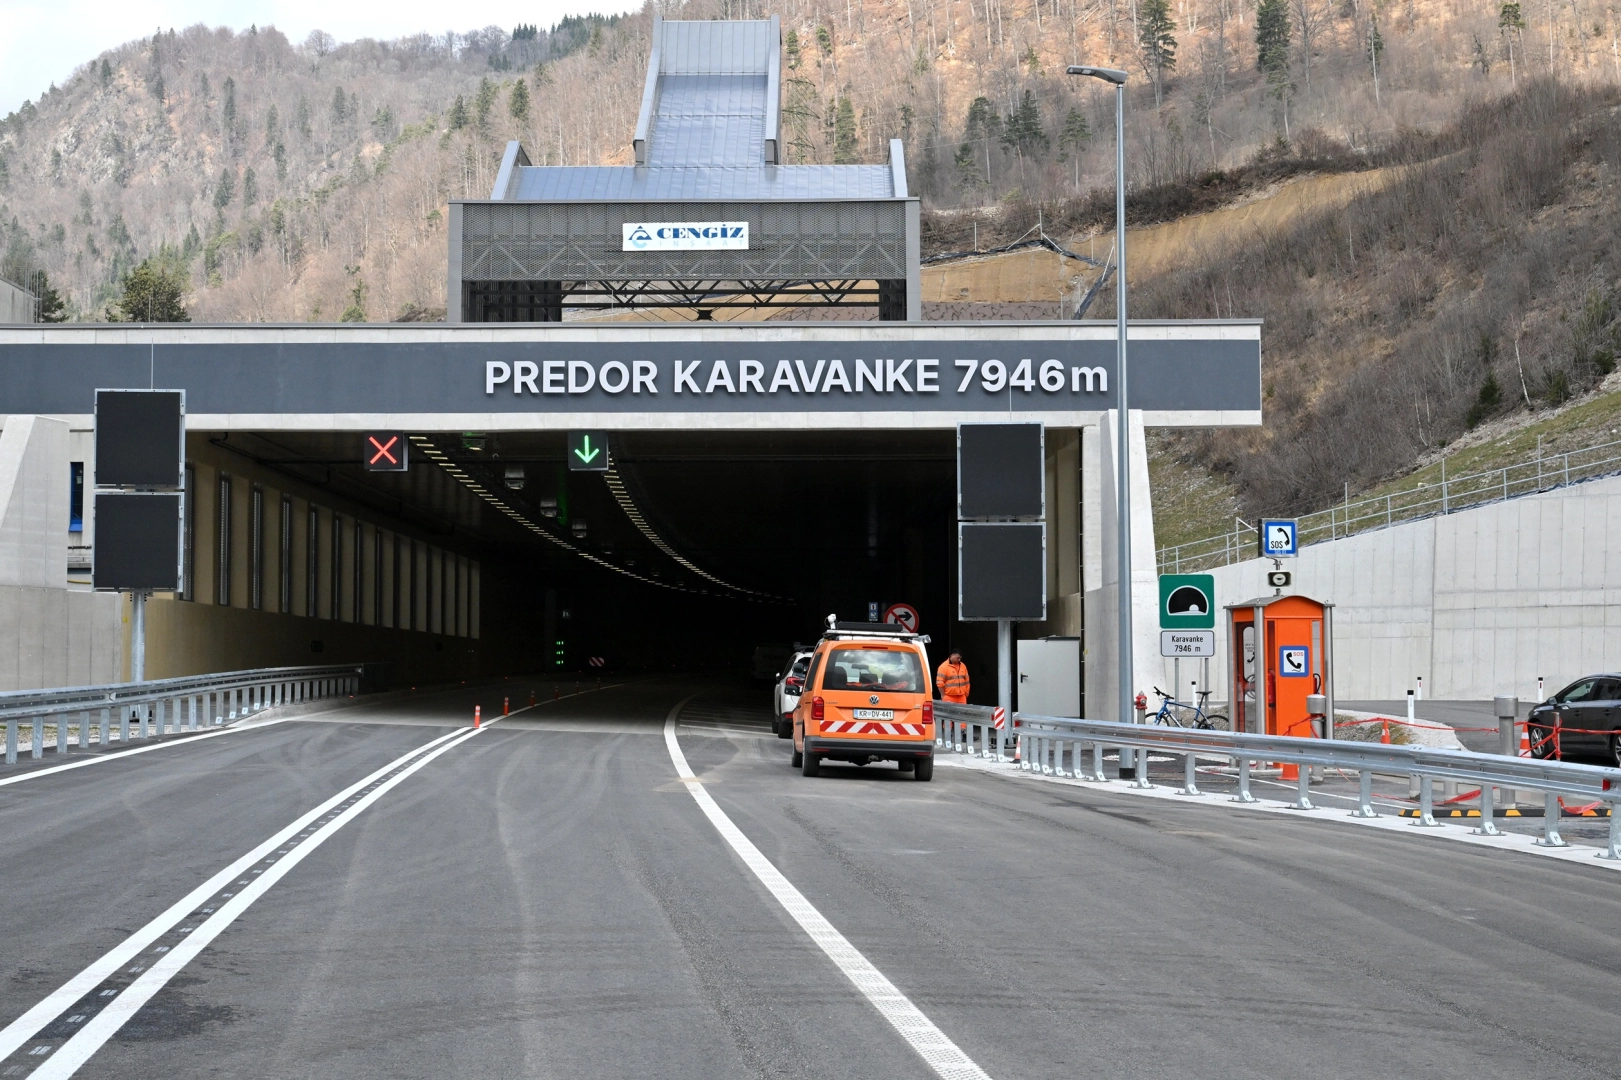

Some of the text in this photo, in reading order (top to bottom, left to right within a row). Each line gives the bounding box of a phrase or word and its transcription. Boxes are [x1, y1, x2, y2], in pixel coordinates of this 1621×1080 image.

[656, 224, 744, 239] CENGİZ
[485, 360, 659, 395] PREDOR
[674, 359, 940, 394] KARAVANKE
[1270, 540, 1284, 549] SOS
[1171, 635, 1204, 643] Karavanke
[1174, 644, 1192, 653] 7946
